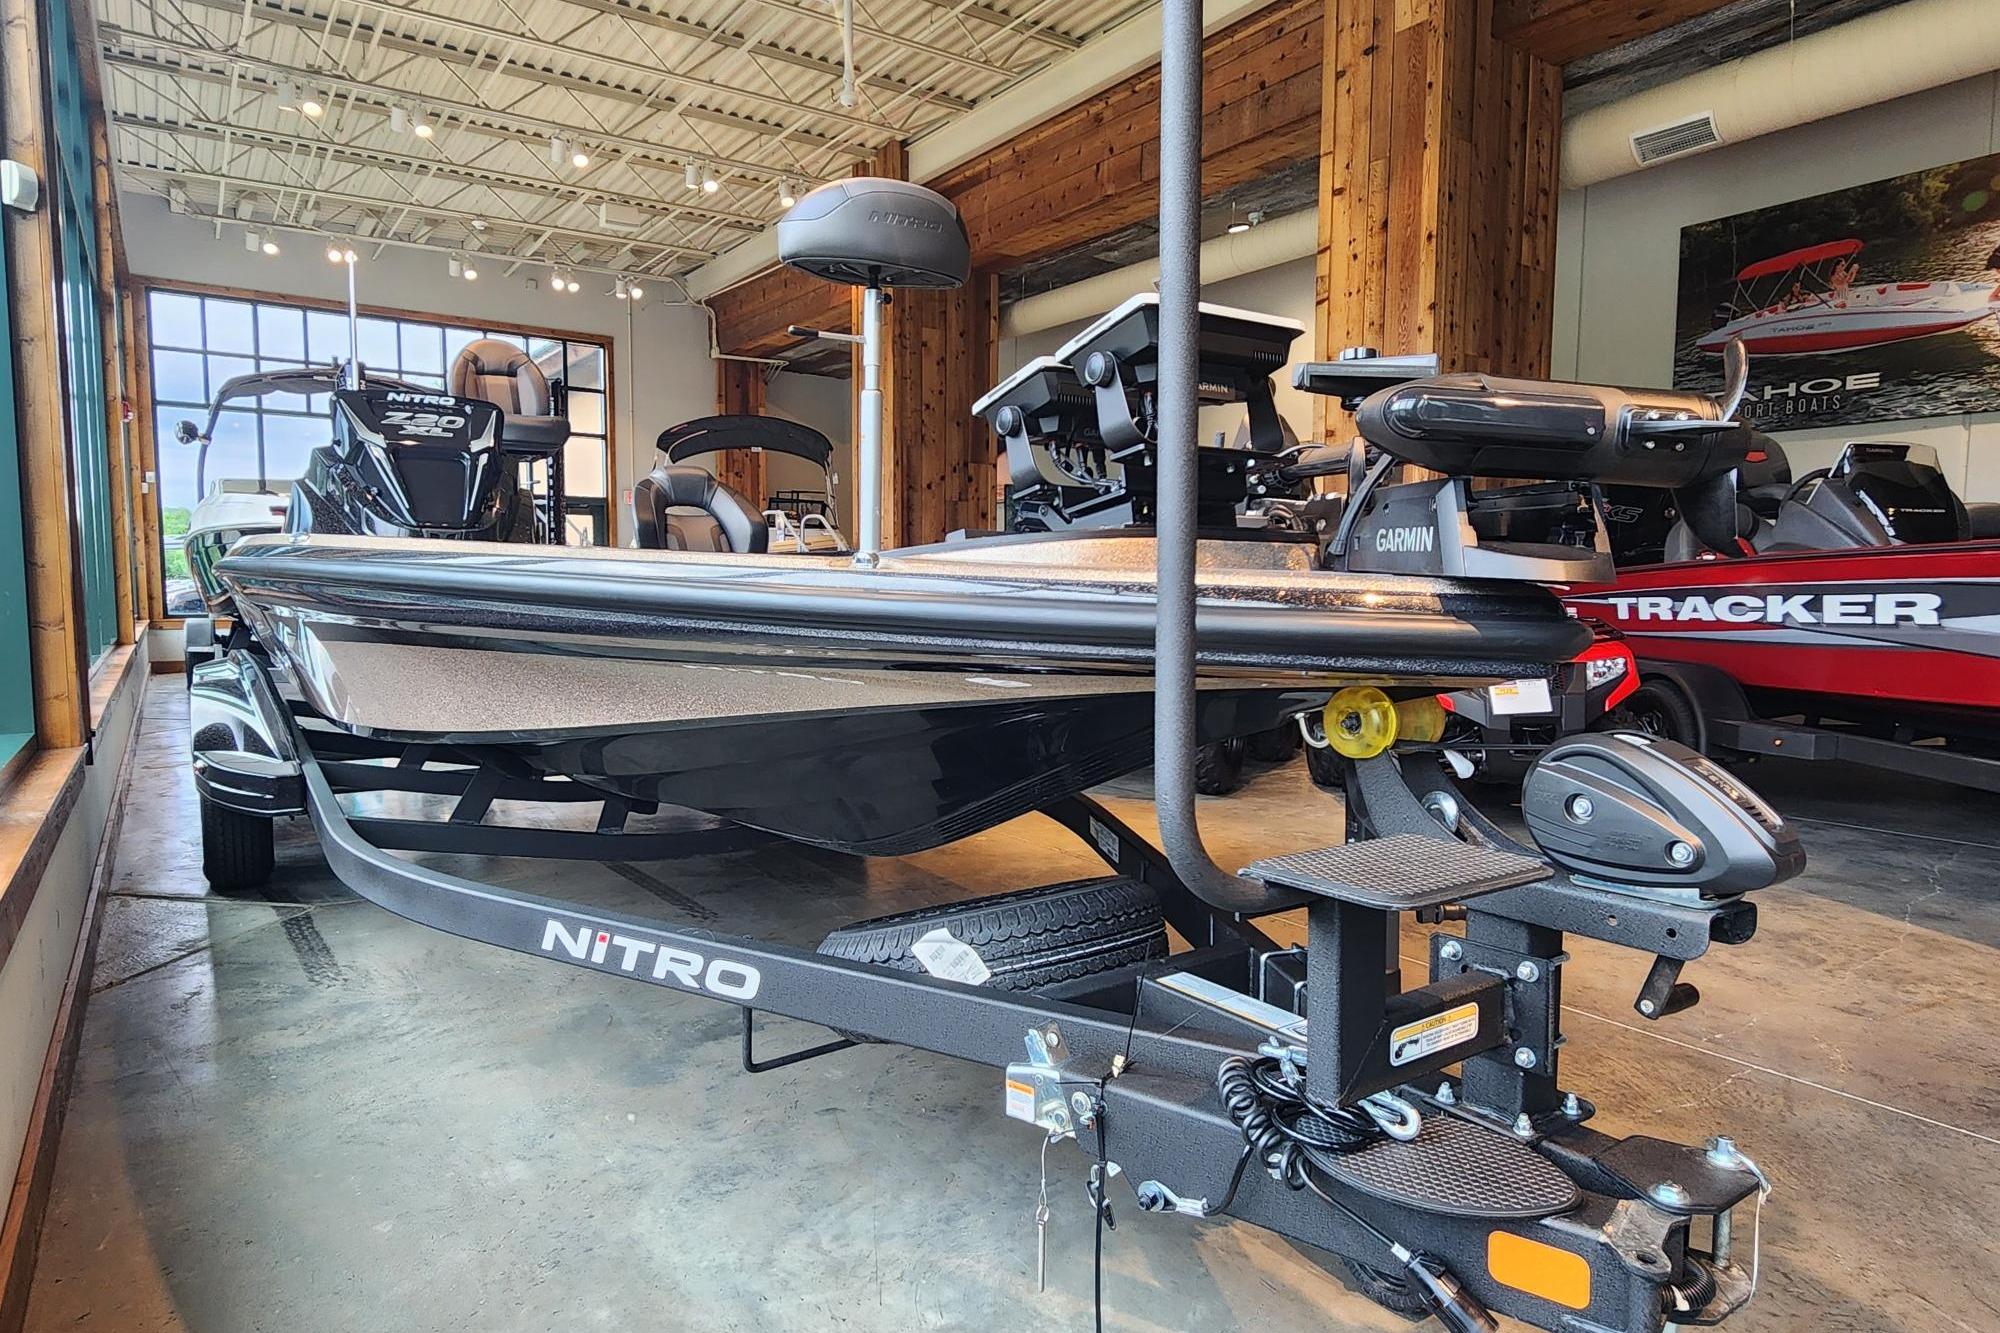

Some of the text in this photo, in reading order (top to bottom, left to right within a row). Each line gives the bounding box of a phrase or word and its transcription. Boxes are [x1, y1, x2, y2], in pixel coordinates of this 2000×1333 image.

[1197, 382, 1229, 393] ARMIN
[1785, 394, 1841, 415] BOATS
[380, 411, 466, 429] Z20
[398, 424, 454, 438] XL
[1376, 526, 1434, 553] GARMIN
[1608, 592, 1942, 626] TRACKER
[541, 919, 761, 1000] NITRO
